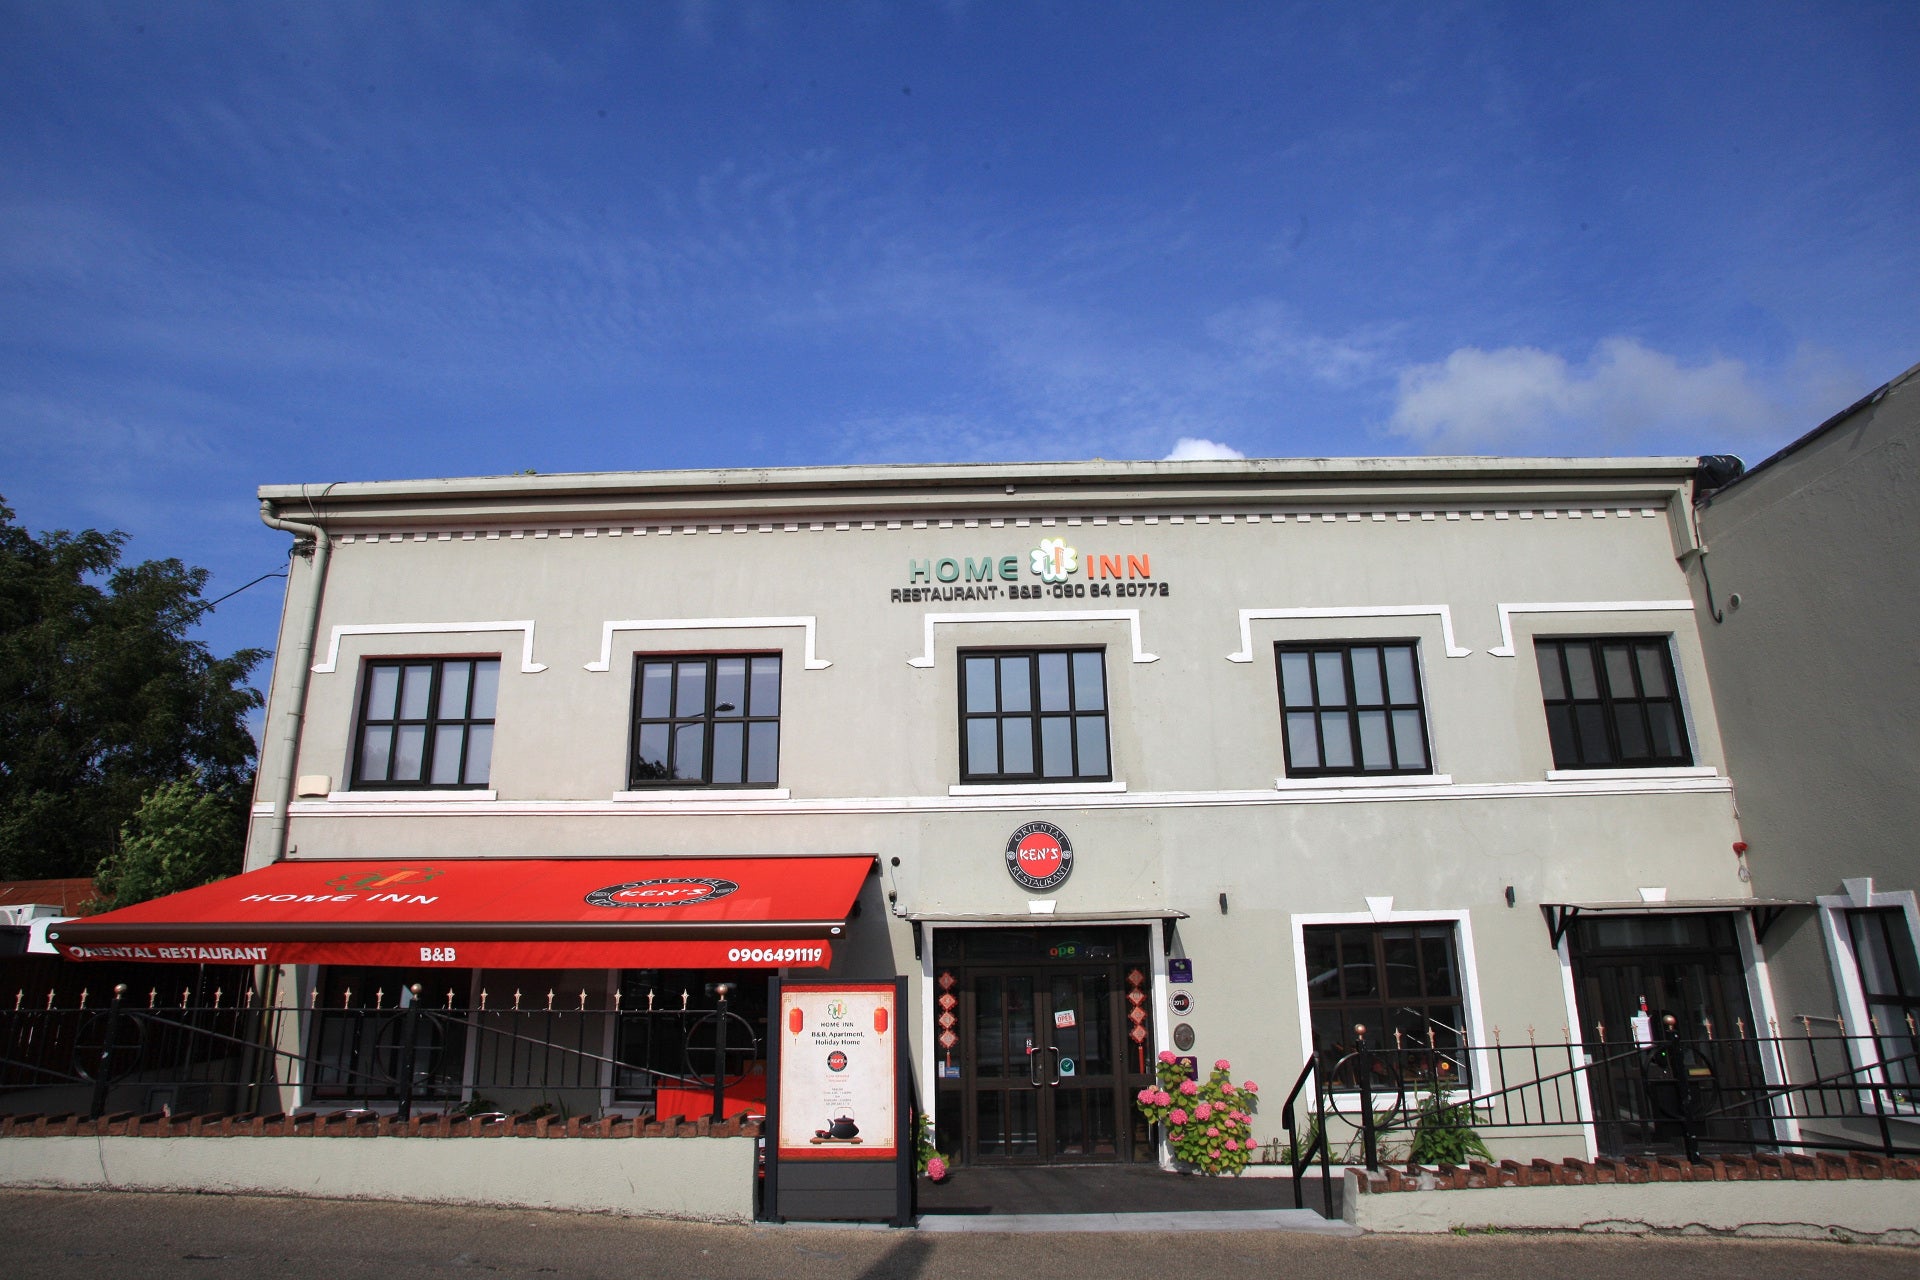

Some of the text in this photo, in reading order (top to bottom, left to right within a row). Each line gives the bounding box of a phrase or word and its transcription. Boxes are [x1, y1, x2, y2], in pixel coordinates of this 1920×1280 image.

[909, 553, 1152, 583] HOME INN
[890, 581, 1169, 603] RESTAURANT B&B 090 64 20772
[1014, 824, 1064, 843] ORIENTAL
[1019, 847, 1059, 861] KEN'S
[1012, 864, 1067, 887] RESTAURANT
[240, 893, 440, 905] HOME INN
[619, 888, 707, 897] KEN'S
[69, 946, 267, 961] ORIENTAL RESTAURANT
[420, 946, 456, 962] B&B
[728, 948, 822, 962] 0906491119
[829, 1031, 865, 1039] Apartment,
[815, 1039, 840, 1047] Holiday
